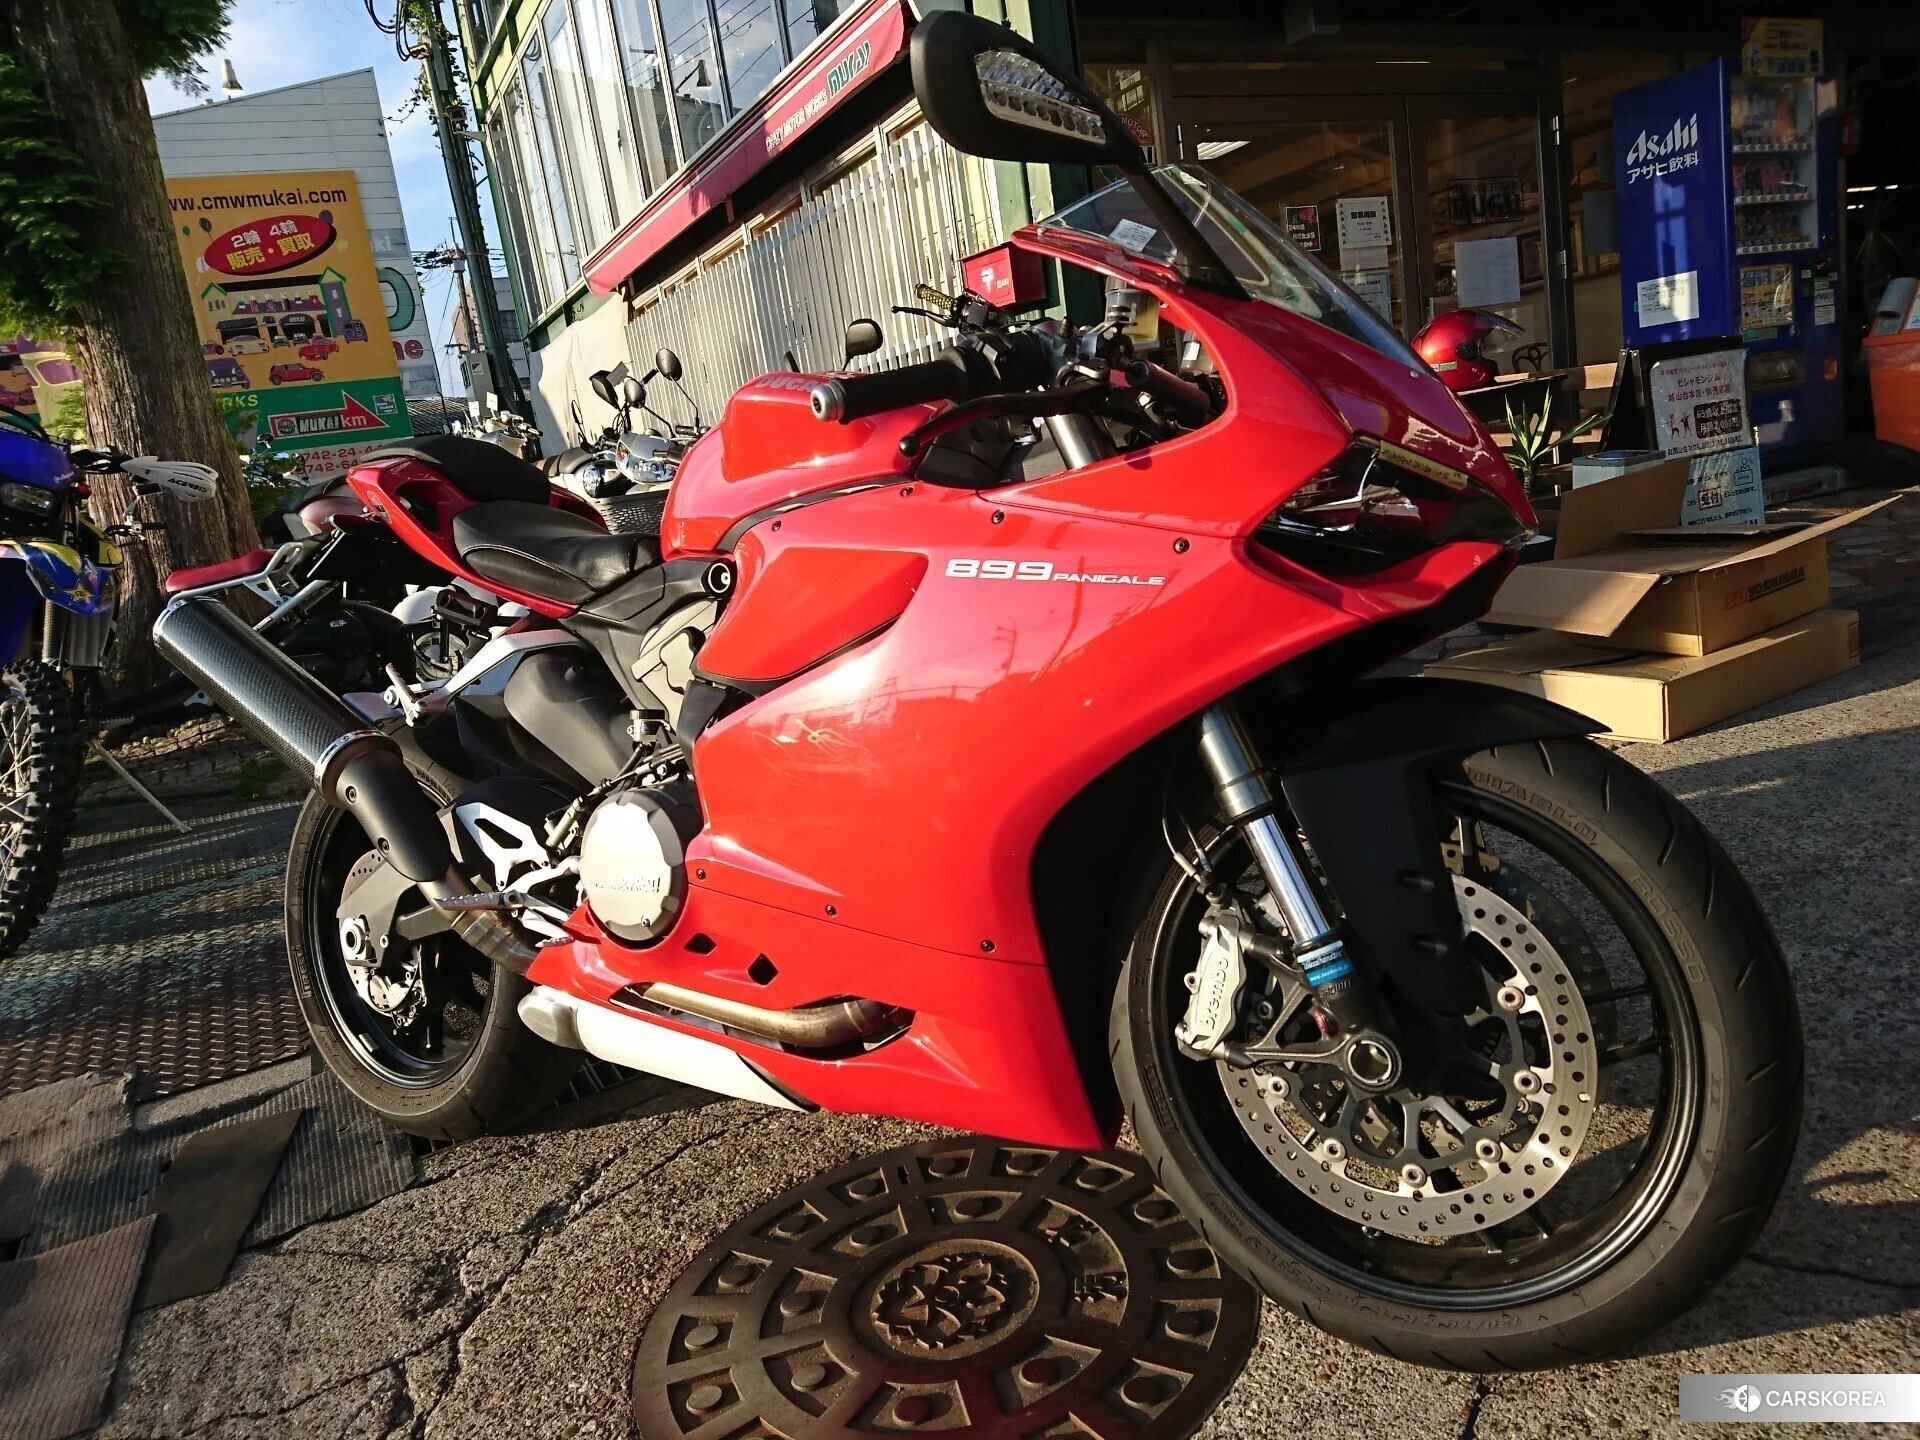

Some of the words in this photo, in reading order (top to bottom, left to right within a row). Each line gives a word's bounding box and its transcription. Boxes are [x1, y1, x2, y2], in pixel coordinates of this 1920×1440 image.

[1121, 116, 1148, 139] MOTOR
[1626, 113, 1698, 166] Asahi
[1627, 150, 1699, 184] アサヒ飲料
[231, 230, 260, 248] 2輪
[269, 219, 298, 237] 4輪
[226, 232, 315, 270] 販売・買取
[755, 374, 819, 393] DUCA
[300, 418, 339, 432] MUKAI
[341, 415, 367, 428] km
[304, 443, 383, 464] 742-24-4
[945, 558, 1054, 581] 899
[1053, 572, 1166, 586] PANIGALE
[1200, 957, 1229, 1031] brembo
